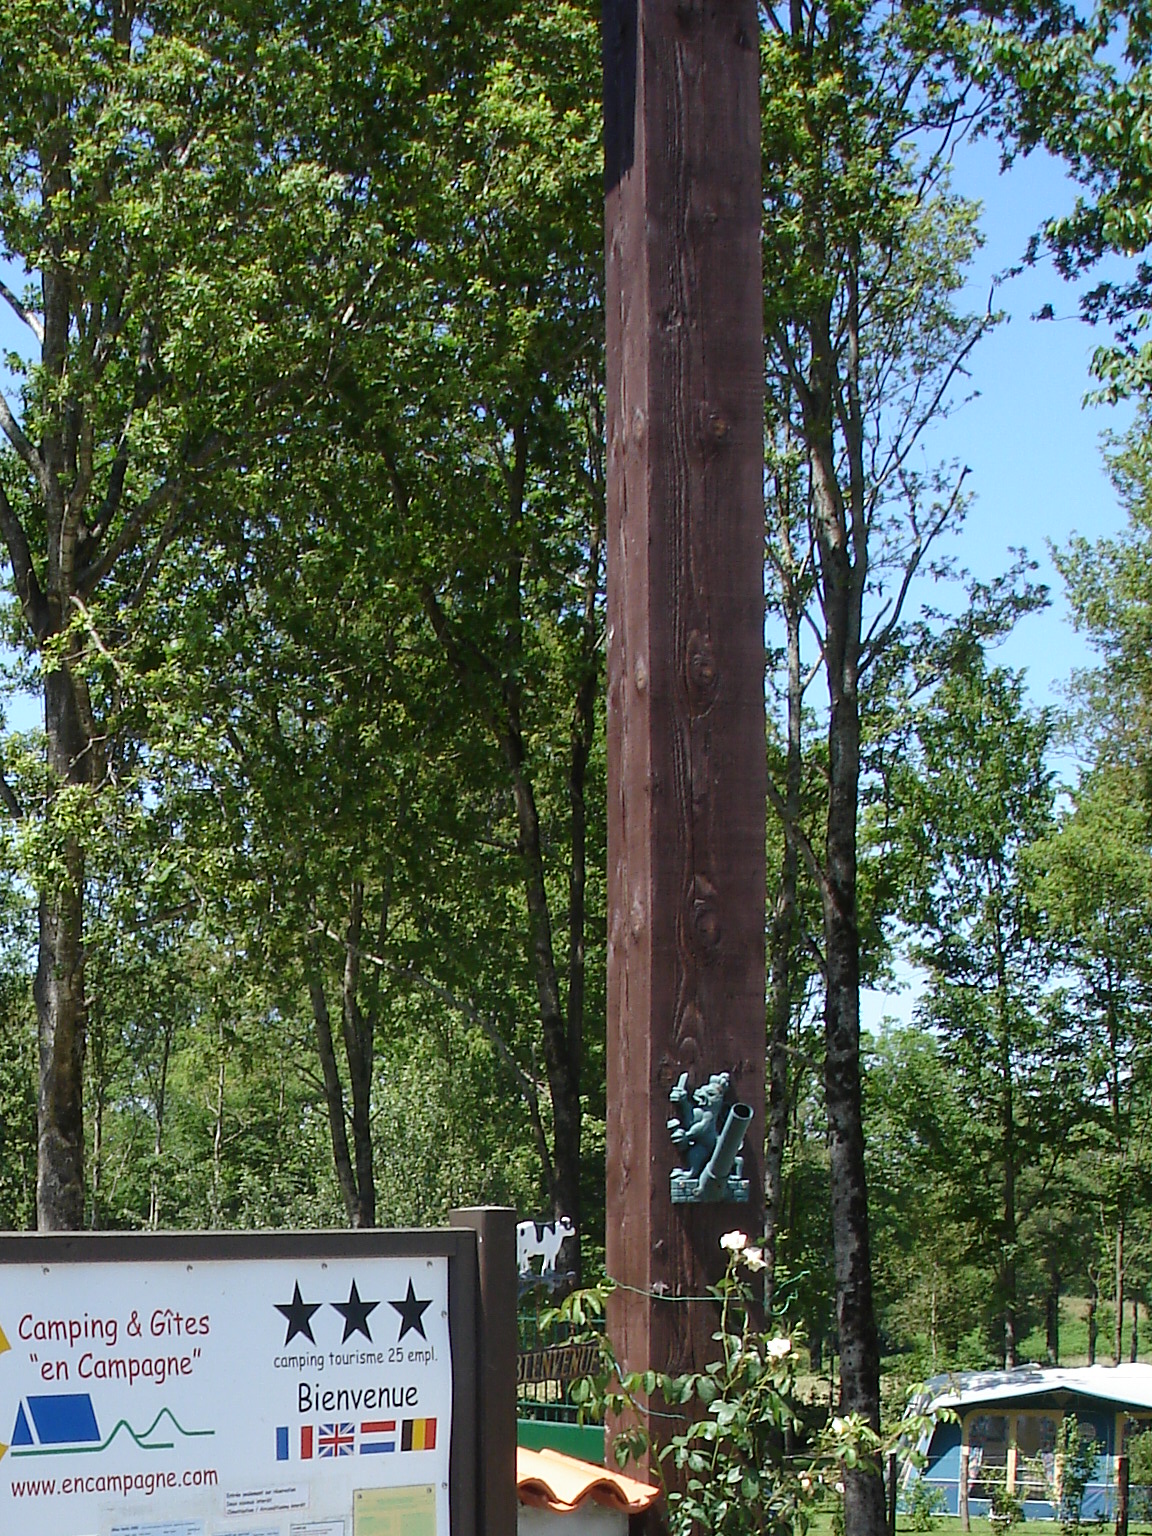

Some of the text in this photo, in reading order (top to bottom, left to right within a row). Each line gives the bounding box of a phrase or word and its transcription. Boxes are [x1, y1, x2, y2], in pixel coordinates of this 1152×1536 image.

[18, 1309, 210, 1347] Camping & Gîtes
[78, 1348, 202, 1386] Campagne"
[273, 1346, 439, 1371] camping tourisme 25 empl.
[298, 1382, 419, 1413] Bienvenue
[11, 1469, 219, 1497] www.encampagne.com
